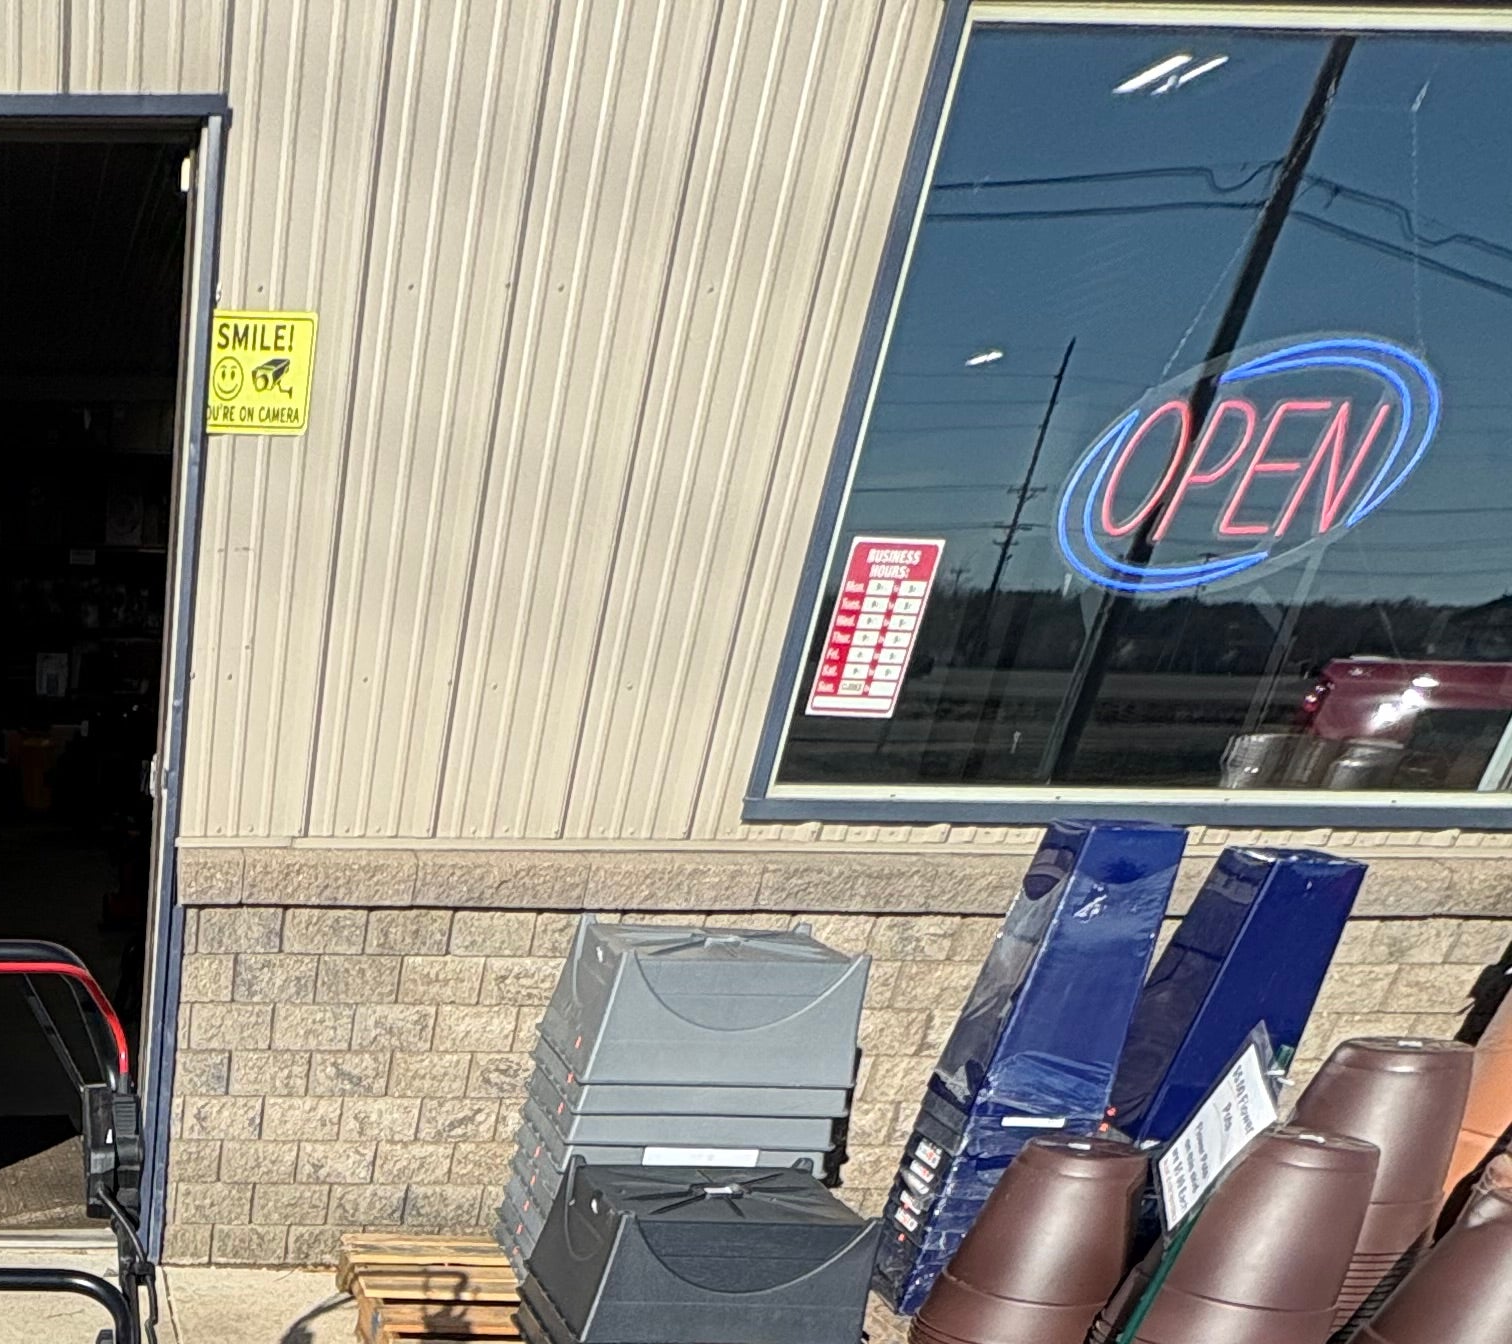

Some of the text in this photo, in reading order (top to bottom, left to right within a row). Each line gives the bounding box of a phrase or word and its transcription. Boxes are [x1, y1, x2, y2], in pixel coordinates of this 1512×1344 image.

[217, 323, 295, 352] SMILE!
[206, 404, 299, 423] OU'RE ON CAMERA
[1101, 399, 1390, 542] OPEN
[867, 549, 922, 565] BUSINESS
[869, 564, 910, 578] HOURS:
